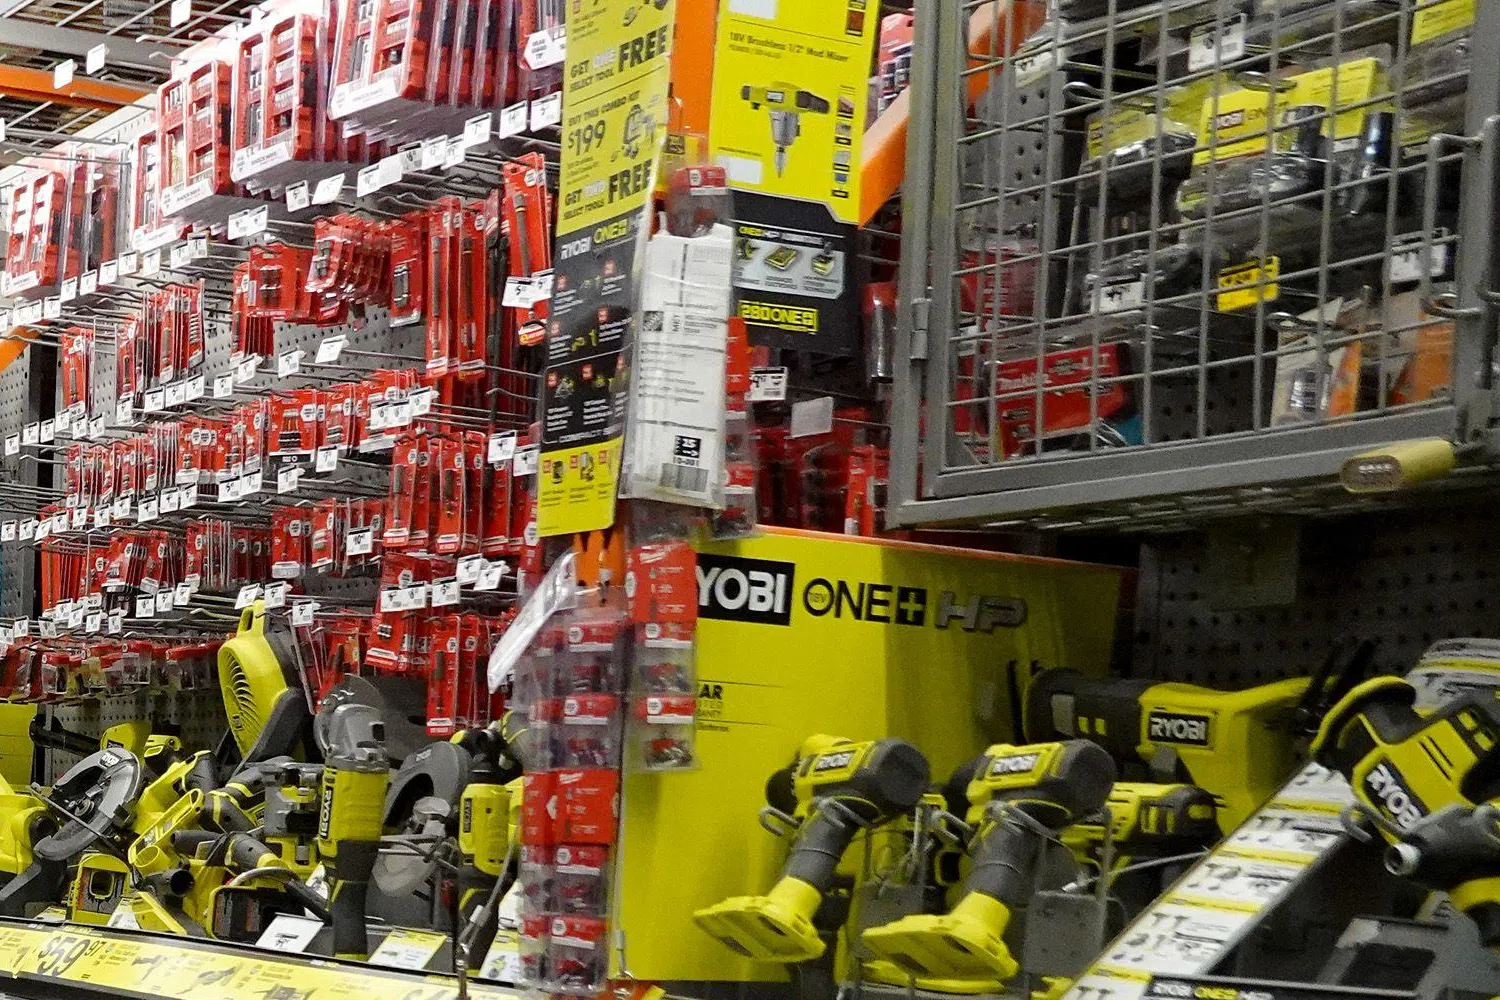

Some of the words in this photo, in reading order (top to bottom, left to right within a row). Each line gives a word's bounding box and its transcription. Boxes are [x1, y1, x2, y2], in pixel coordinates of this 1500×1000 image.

[618, 24, 668, 73] FREE
[570, 60, 590, 78] GET
[568, 120, 606, 157] $199
[608, 159, 652, 204] FREE
[564, 188, 583, 207] GET
[561, 236, 592, 260] RYOBI
[696, 567, 788, 614] YOBI
[936, 591, 1028, 634] HP
[698, 684, 723, 700] AR
[1150, 716, 1207, 741] RYOBI
[817, 753, 850, 769] RYOBI
[993, 755, 1038, 773] RYOBI
[1366, 763, 1423, 831] RYOB
[319, 787, 332, 838] RYOBI
